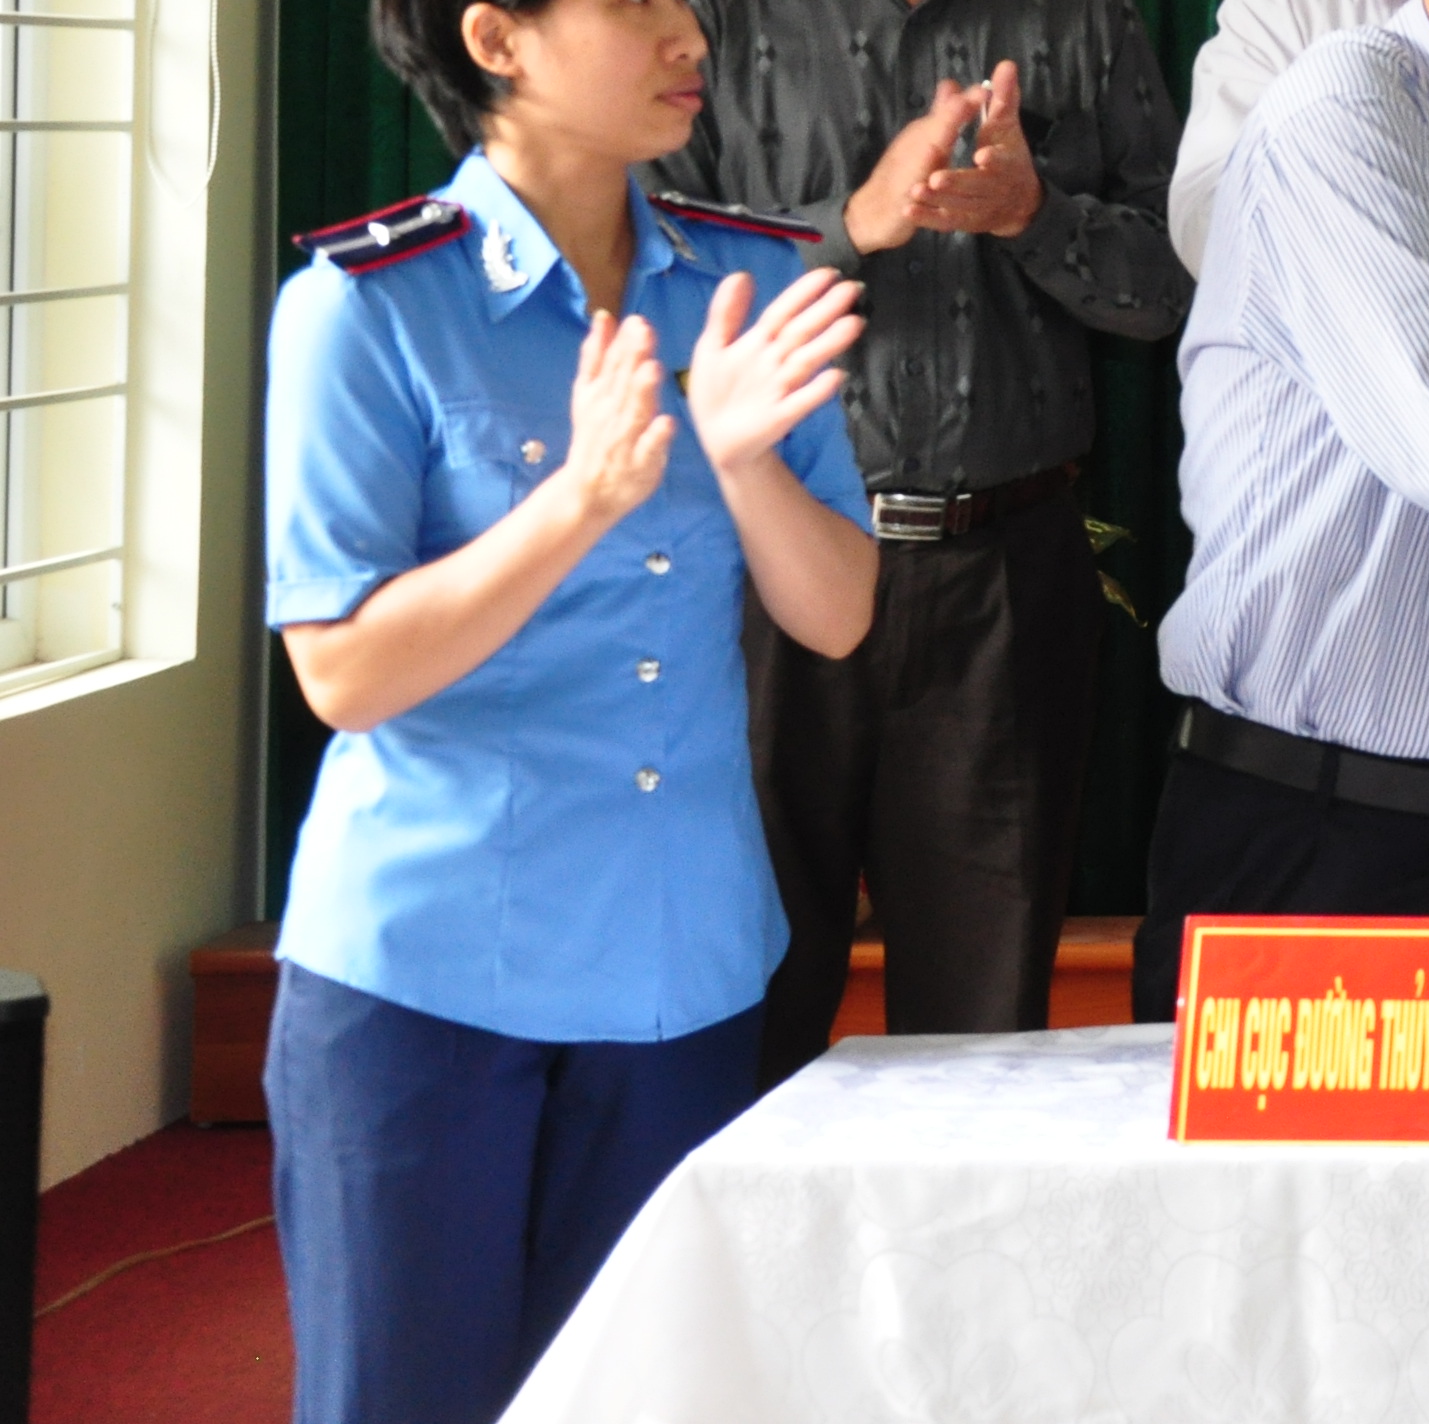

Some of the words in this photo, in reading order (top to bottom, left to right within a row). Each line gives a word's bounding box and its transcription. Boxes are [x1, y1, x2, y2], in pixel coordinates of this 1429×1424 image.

[1197, 997, 1241, 1091] CHI
[1240, 997, 1292, 1111] CỤC
[1292, 976, 1376, 1091] ĐƯỜNG
